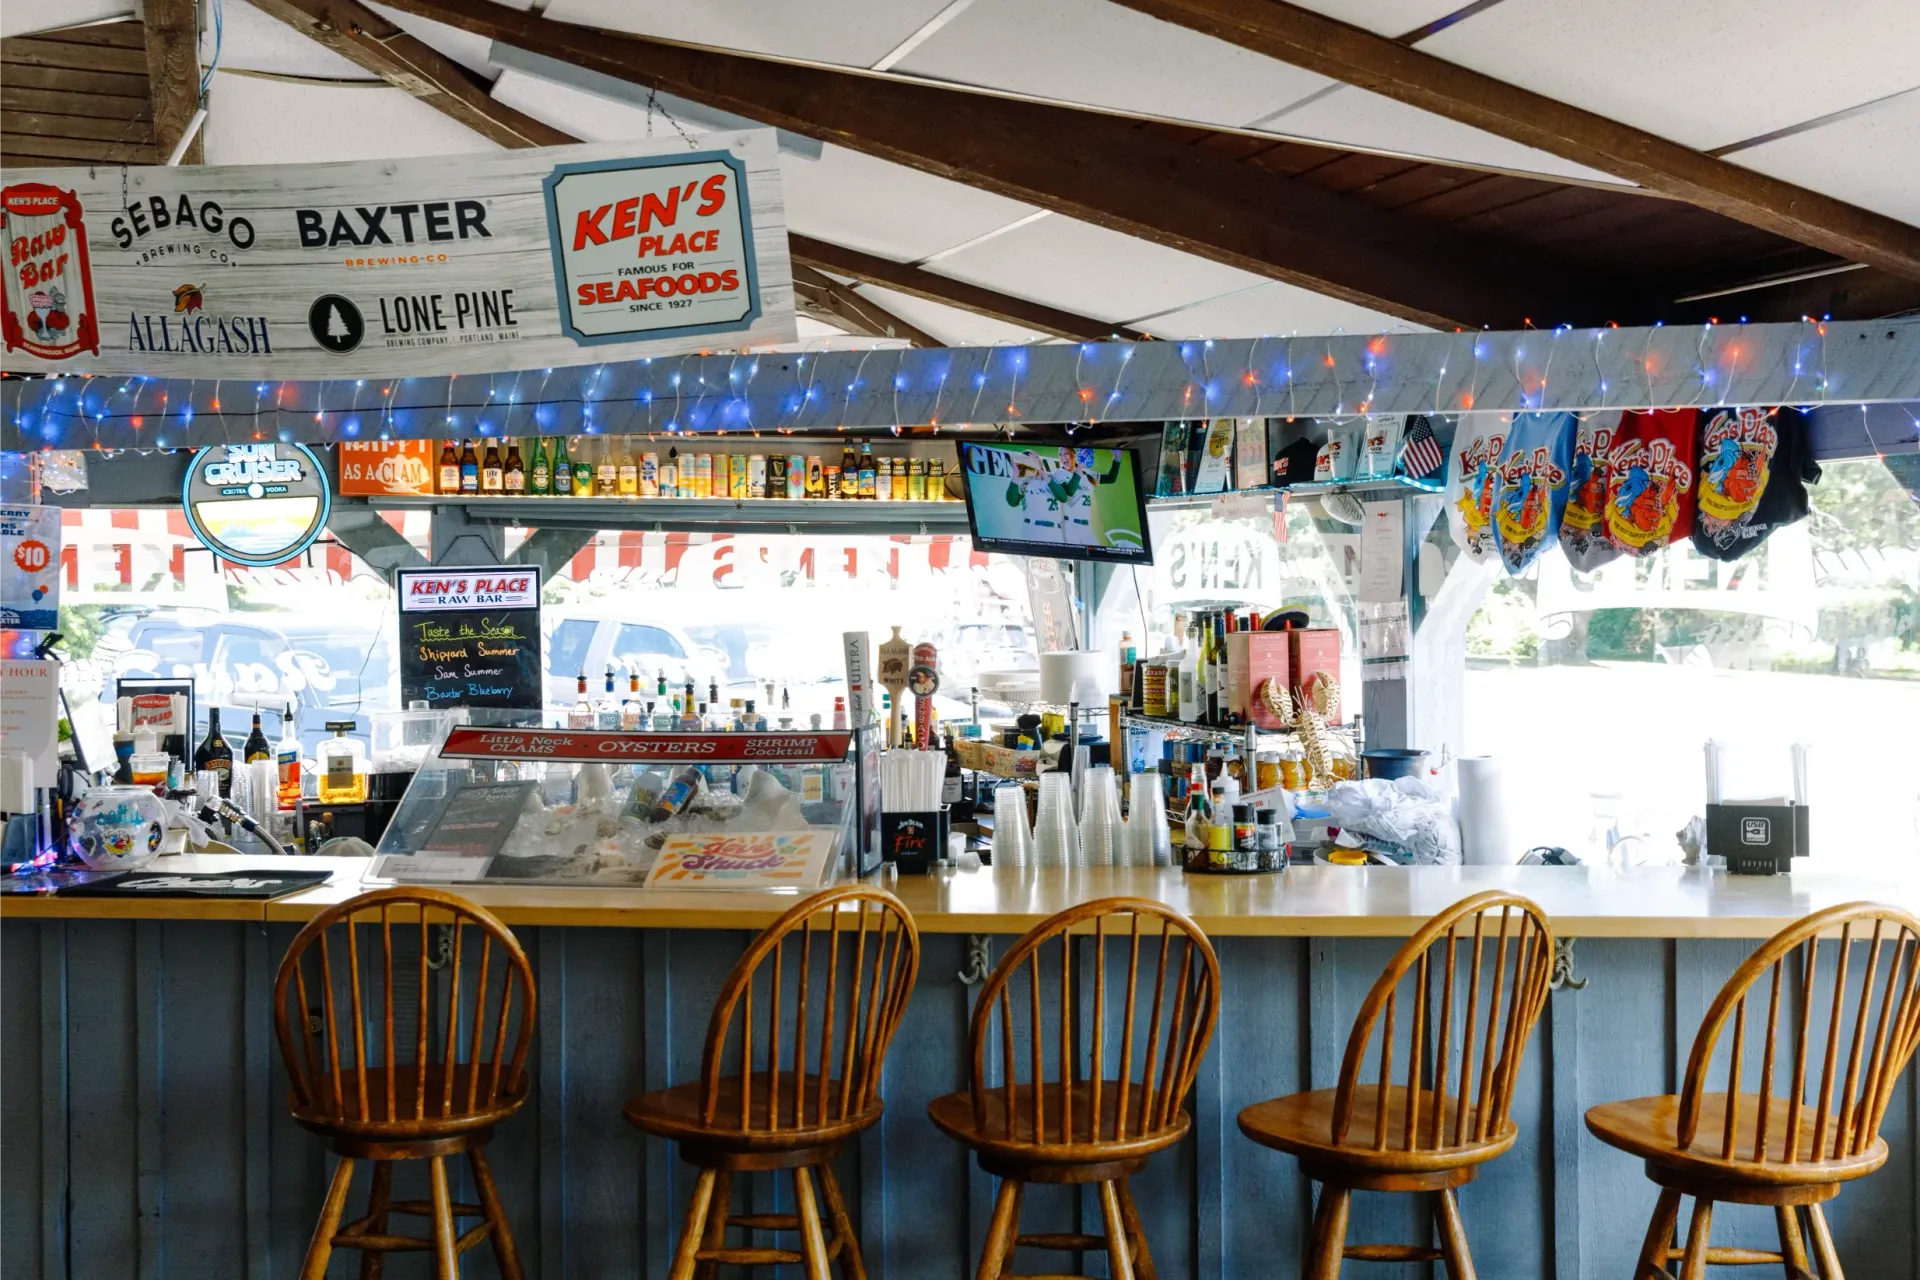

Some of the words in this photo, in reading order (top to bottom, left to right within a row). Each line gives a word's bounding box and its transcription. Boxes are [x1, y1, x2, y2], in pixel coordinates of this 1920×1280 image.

[8, 197, 31, 206] KEN'S
[32, 197, 59, 206] PLACE
[111, 193, 256, 250] SEBAGO
[572, 174, 728, 251] KEN'S
[296, 200, 493, 248] BAXTER
[11, 223, 67, 267] Raw
[142, 244, 201, 263] BREWING
[638, 230, 720, 258] PLACE
[345, 255, 419, 267] BREWING
[617, 263, 668, 277] FAMOUS
[672, 261, 695, 271] FOR
[20, 253, 68, 289] Bar
[577, 269, 740, 306] SEAFOODS
[379, 294, 448, 334] LONE
[454, 289, 518, 329] PINE
[629, 302, 664, 313] SINCE
[668, 299, 693, 309] 1927
[129, 311, 273, 355] ALLAGASH
[498, 331, 520, 341] MAINE
[205, 460, 303, 486] CRUISER
[343, 464, 361, 480] AS
[365, 464, 376, 480] A
[382, 463, 422, 483] CLAM
[1650, 441, 1690, 487] Place
[17, 546, 45, 567] $10
[411, 579, 468, 595] KEN'S
[474, 578, 530, 594] PLACE
[438, 595, 470, 604] RAW
[476, 595, 503, 603] BAR
[413, 621, 451, 638] Taste
[459, 623, 475, 636] the
[420, 646, 468, 661] Shipyard
[477, 641, 520, 657] Summer
[849, 639, 862, 683] ULTRA
[9, 668, 48, 677] HOUR
[434, 665, 459, 680] Sam
[464, 663, 504, 678] Summer
[884, 677, 905, 685] WHITE
[479, 734, 524, 744] Little
[530, 736, 574, 745] Neck
[490, 744, 555, 753] CLAMS
[598, 741, 717, 754] OYSTERS
[745, 738, 818, 747] SHRIMP
[743, 747, 815, 756] Cocktail
[894, 834, 925, 854] Fire
